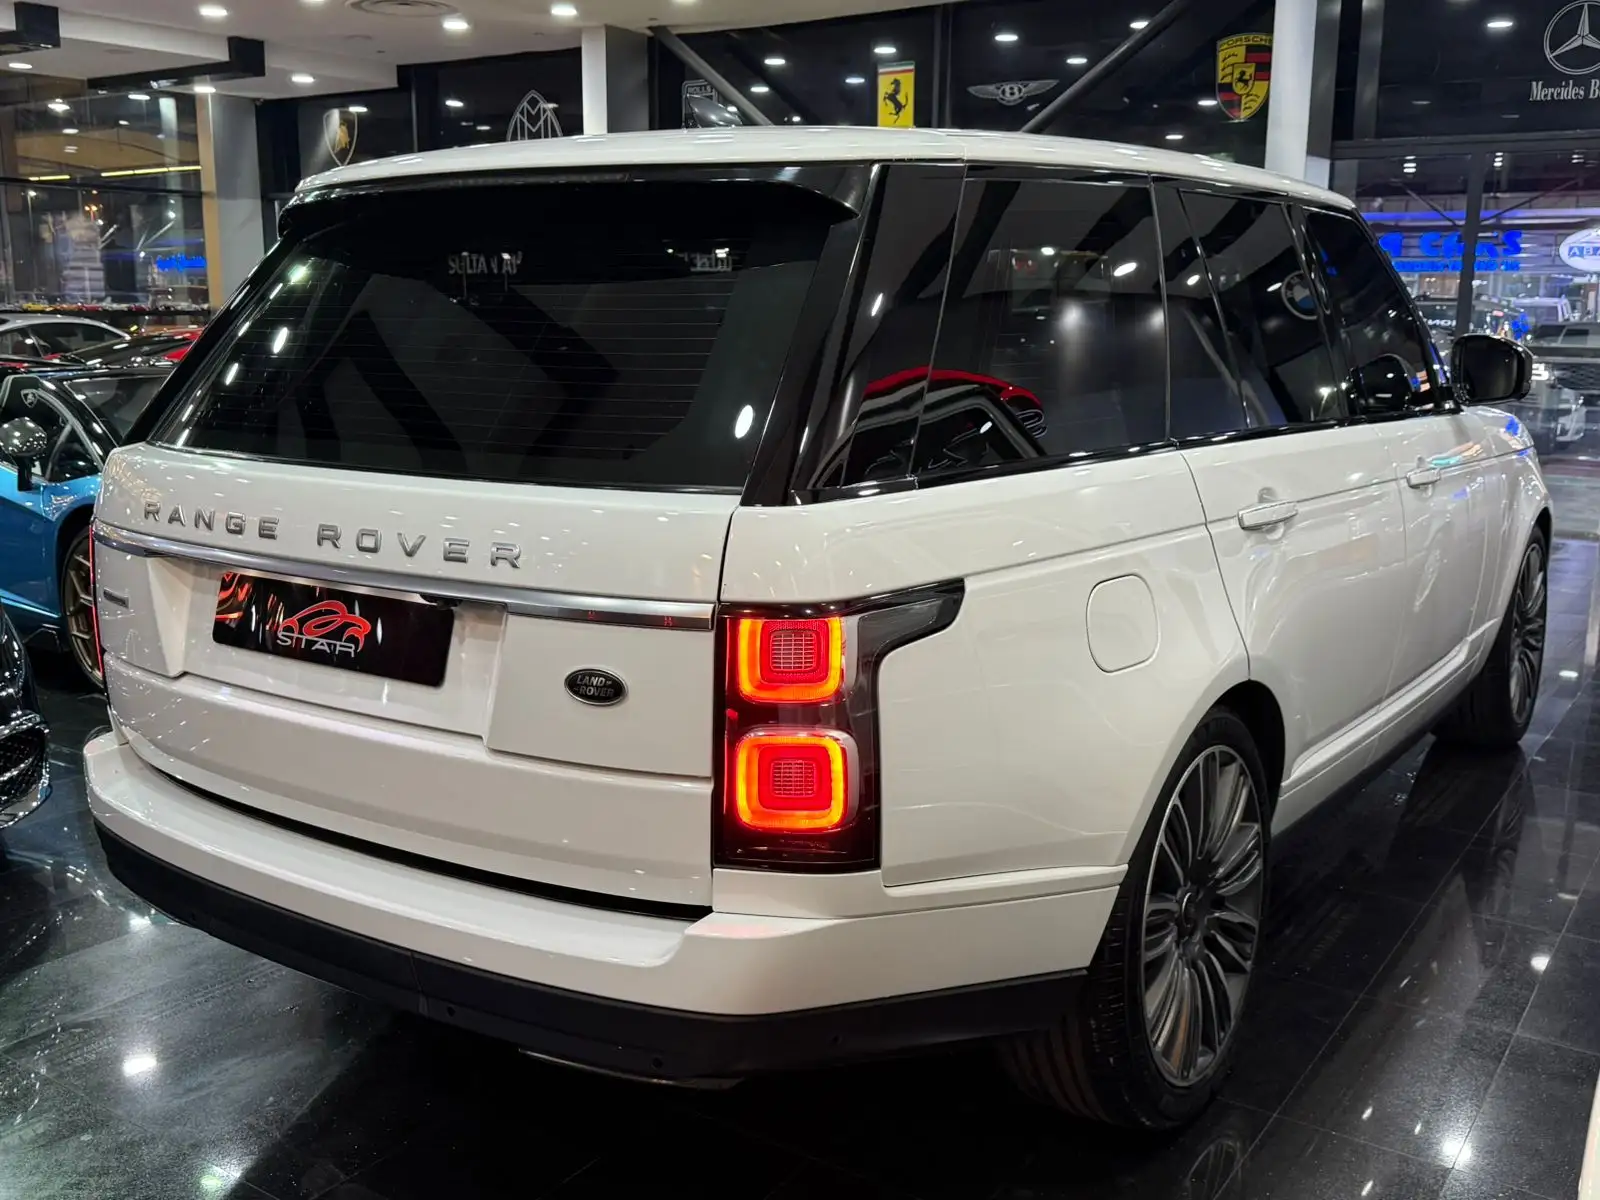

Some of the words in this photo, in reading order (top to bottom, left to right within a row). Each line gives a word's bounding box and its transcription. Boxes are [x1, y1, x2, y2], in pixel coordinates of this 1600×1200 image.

[1529, 80, 1585, 101] Mercides
[1589, 78, 1600, 99] B
[143, 501, 280, 540] RANGE
[316, 523, 522, 569] ROVER
[276, 631, 357, 658] STAR
[576, 674, 606, 687] LAND
[579, 685, 615, 697] ROVER
